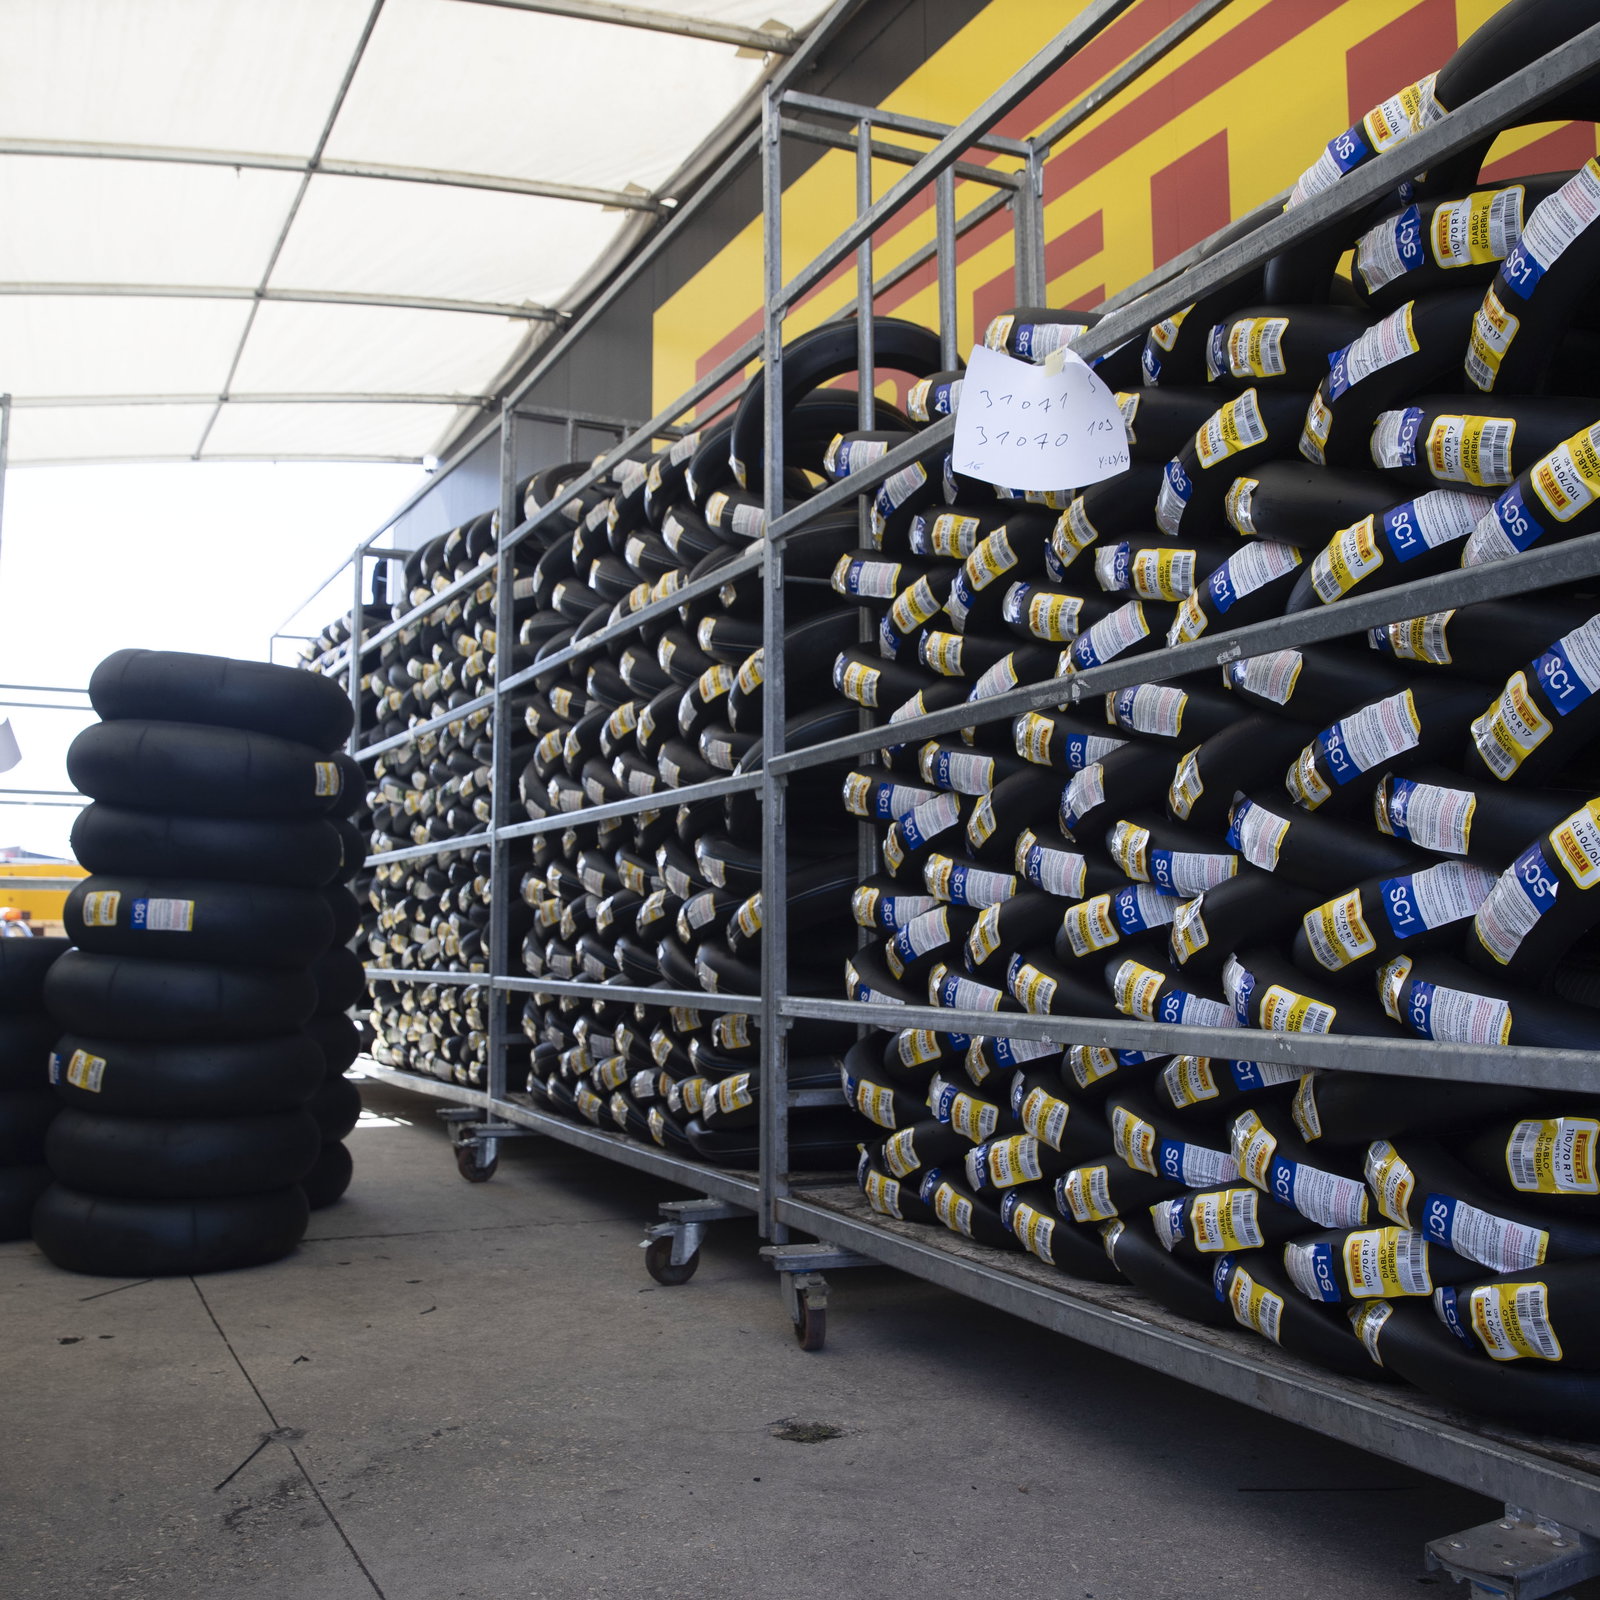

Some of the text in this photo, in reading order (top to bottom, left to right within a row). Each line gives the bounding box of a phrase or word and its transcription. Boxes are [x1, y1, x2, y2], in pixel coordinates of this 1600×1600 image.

[1401, 218, 1416, 258] SC1
[1451, 226, 1462, 258] 110/70
[1506, 249, 1532, 284] SC1
[976, 426, 1069, 450] 31070
[1448, 426, 1455, 435] 17
[1445, 444, 1455, 474] 110/70
[1470, 431, 1480, 474] SUPERBIKE
[1552, 456, 1559, 464] 17
[1575, 450, 1594, 478] DIABLO
[1557, 471, 1580, 501] 110/70
[1392, 512, 1416, 549] SC1
[1502, 496, 1528, 536] SC1
[1330, 546, 1343, 580] SUPERBIKE
[1335, 545, 1344, 570] DIABLO
[1355, 559, 1363, 568] 17
[1214, 570, 1230, 602] SC1
[1544, 657, 1576, 699] SC1
[1516, 721, 1522, 729] R
[1522, 728, 1532, 737] 17
[1070, 741, 1082, 769] SC1
[1328, 736, 1349, 772] SC1
[940, 758, 949, 783] SC1
[880, 789, 890, 813] SC1
[904, 817, 918, 842] SC1
[1572, 820, 1580, 829] 17
[1576, 828, 1584, 836] R
[1560, 830, 1589, 872] PIRELLI
[954, 874, 964, 899] SC1
[1156, 858, 1171, 889] SC1
[1522, 855, 1550, 898] SC1
[134, 904, 145, 923] SC1
[884, 903, 894, 927] SC1
[1120, 895, 1138, 925] SC1
[1390, 886, 1416, 926] SC1
[1322, 916, 1340, 954] SUPERBIKE
[1328, 918, 1339, 945] DIABLO
[1339, 903, 1348, 930] 110/70
[1350, 939, 1357, 948] 17
[1165, 997, 1180, 1022] SC
[1279, 998, 1285, 1006] 17
[1414, 994, 1428, 1033] SC1
[1236, 1060, 1255, 1083] C1
[1535, 1132, 1546, 1178] SUPERBIKE
[1543, 1137, 1552, 1169] DIABLO
[1563, 1128, 1574, 1161] 110/70
[1166, 1147, 1180, 1178] SC1
[1276, 1166, 1291, 1202] SC1
[1565, 1173, 1574, 1183] 17
[1205, 1218, 1216, 1243] 110/70
[1219, 1209, 1228, 1235] DIABLO
[1225, 1201, 1236, 1239] SUPERBIKE
[1430, 1200, 1448, 1240] SC1
[1364, 1239, 1370, 1248] 17
[1318, 1255, 1333, 1292] SC1
[1362, 1258, 1373, 1288] 110/70
[1382, 1249, 1390, 1279] DIABLO
[1388, 1241, 1398, 1283] SUPERBIKE
[1486, 1297, 1491, 1307] 17
[1445, 1300, 1464, 1338] SC1
[1502, 1309, 1517, 1342] DIABLO
[1508, 1299, 1528, 1346] SUPERBIKE
[1488, 1320, 1504, 1350] 110/70
